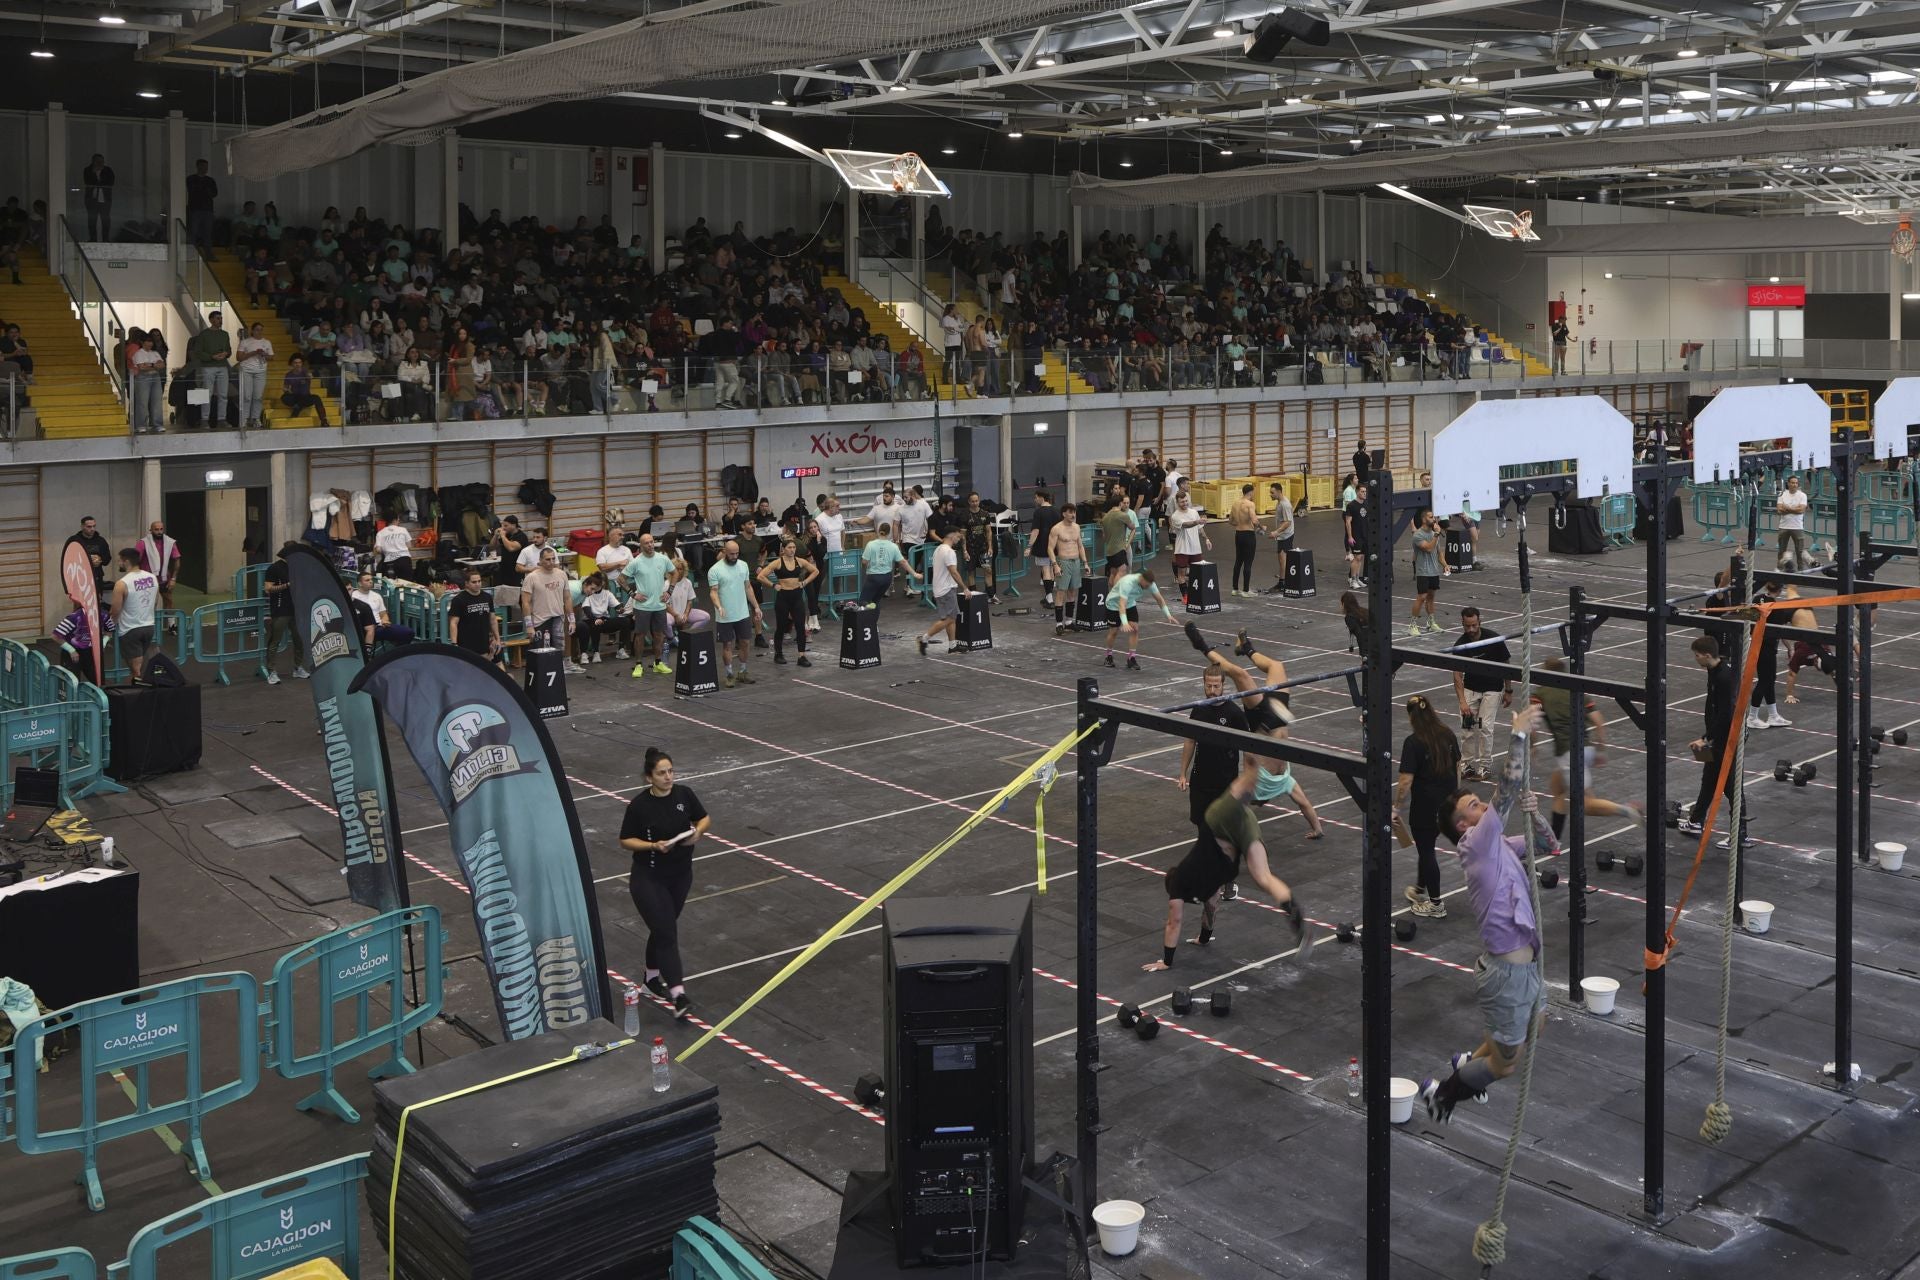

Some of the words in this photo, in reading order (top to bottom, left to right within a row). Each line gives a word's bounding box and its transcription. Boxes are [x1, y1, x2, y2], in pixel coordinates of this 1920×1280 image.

[894, 438, 933, 450] Deporte
[784, 469, 795, 478] UP
[1448, 542, 1459, 553] 10
[1461, 542, 1471, 553] 10
[1289, 565, 1297, 576] 6
[1304, 564, 1311, 576] 6
[1192, 578, 1199, 590] 4
[1207, 578, 1215, 590] 4
[1081, 593, 1088, 606] 2
[1097, 593, 1105, 606] 2
[976, 610, 982, 624] 1
[846, 627, 854, 641] 3
[863, 627, 872, 641] 3
[681, 650, 687, 665] 5
[698, 650, 708, 665] 5
[859, 656, 879, 665] ZIVA
[528, 671, 535, 687] 7
[546, 671, 557, 687] 7
[692, 681, 716, 691] ZIVA
[539, 704, 566, 715] ZIVA
[136, 1041, 155, 1049] RURAL
[281, 1243, 304, 1254] RURAL
